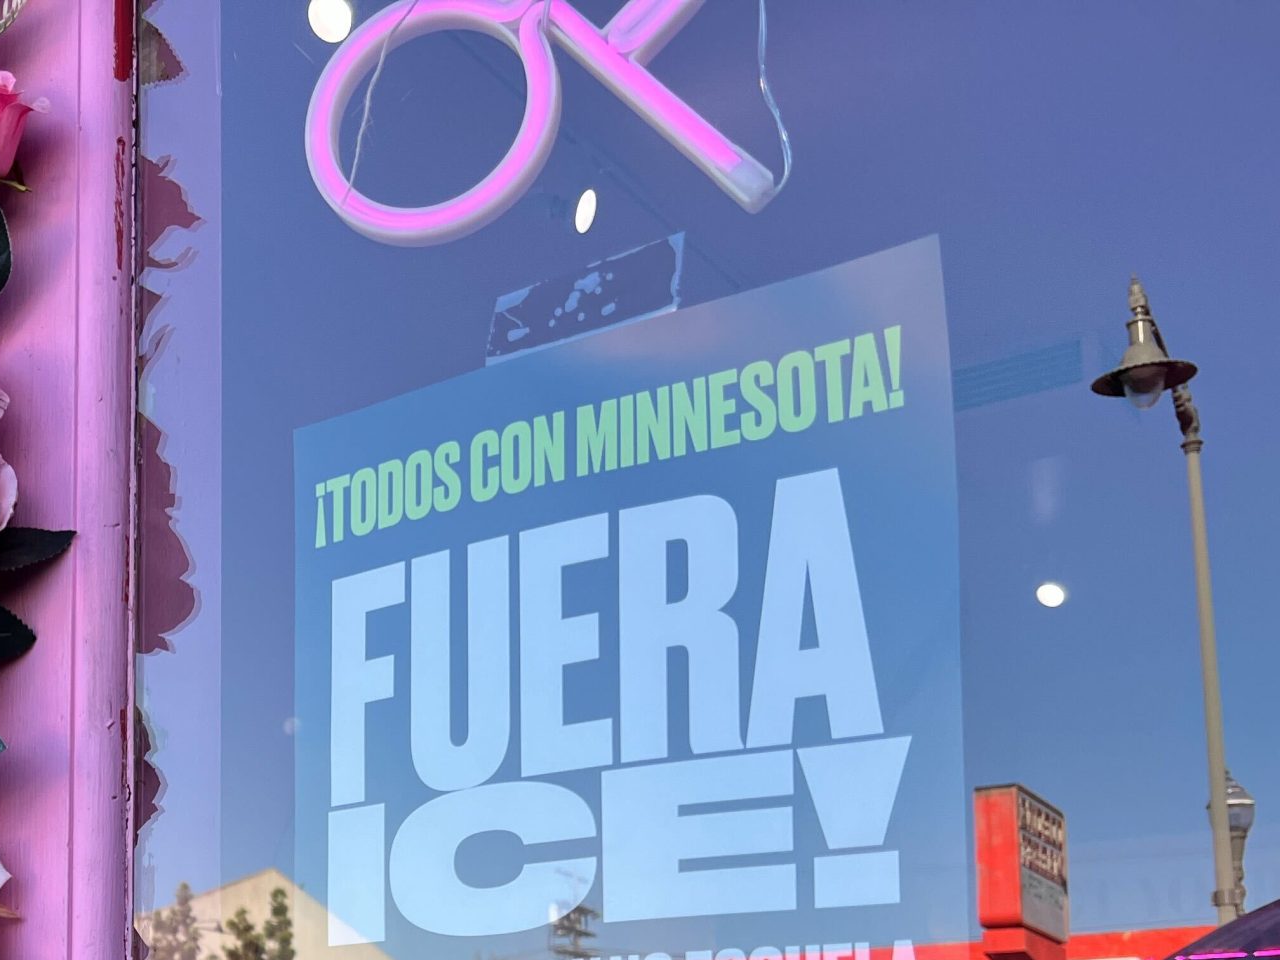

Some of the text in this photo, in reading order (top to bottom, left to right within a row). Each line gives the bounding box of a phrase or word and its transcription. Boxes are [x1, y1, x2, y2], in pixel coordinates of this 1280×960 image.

[314, 325, 905, 549] ¡TODOS CON MINNESOTA!
[330, 467, 885, 807] FUERA
[327, 735, 912, 947] ICE!
